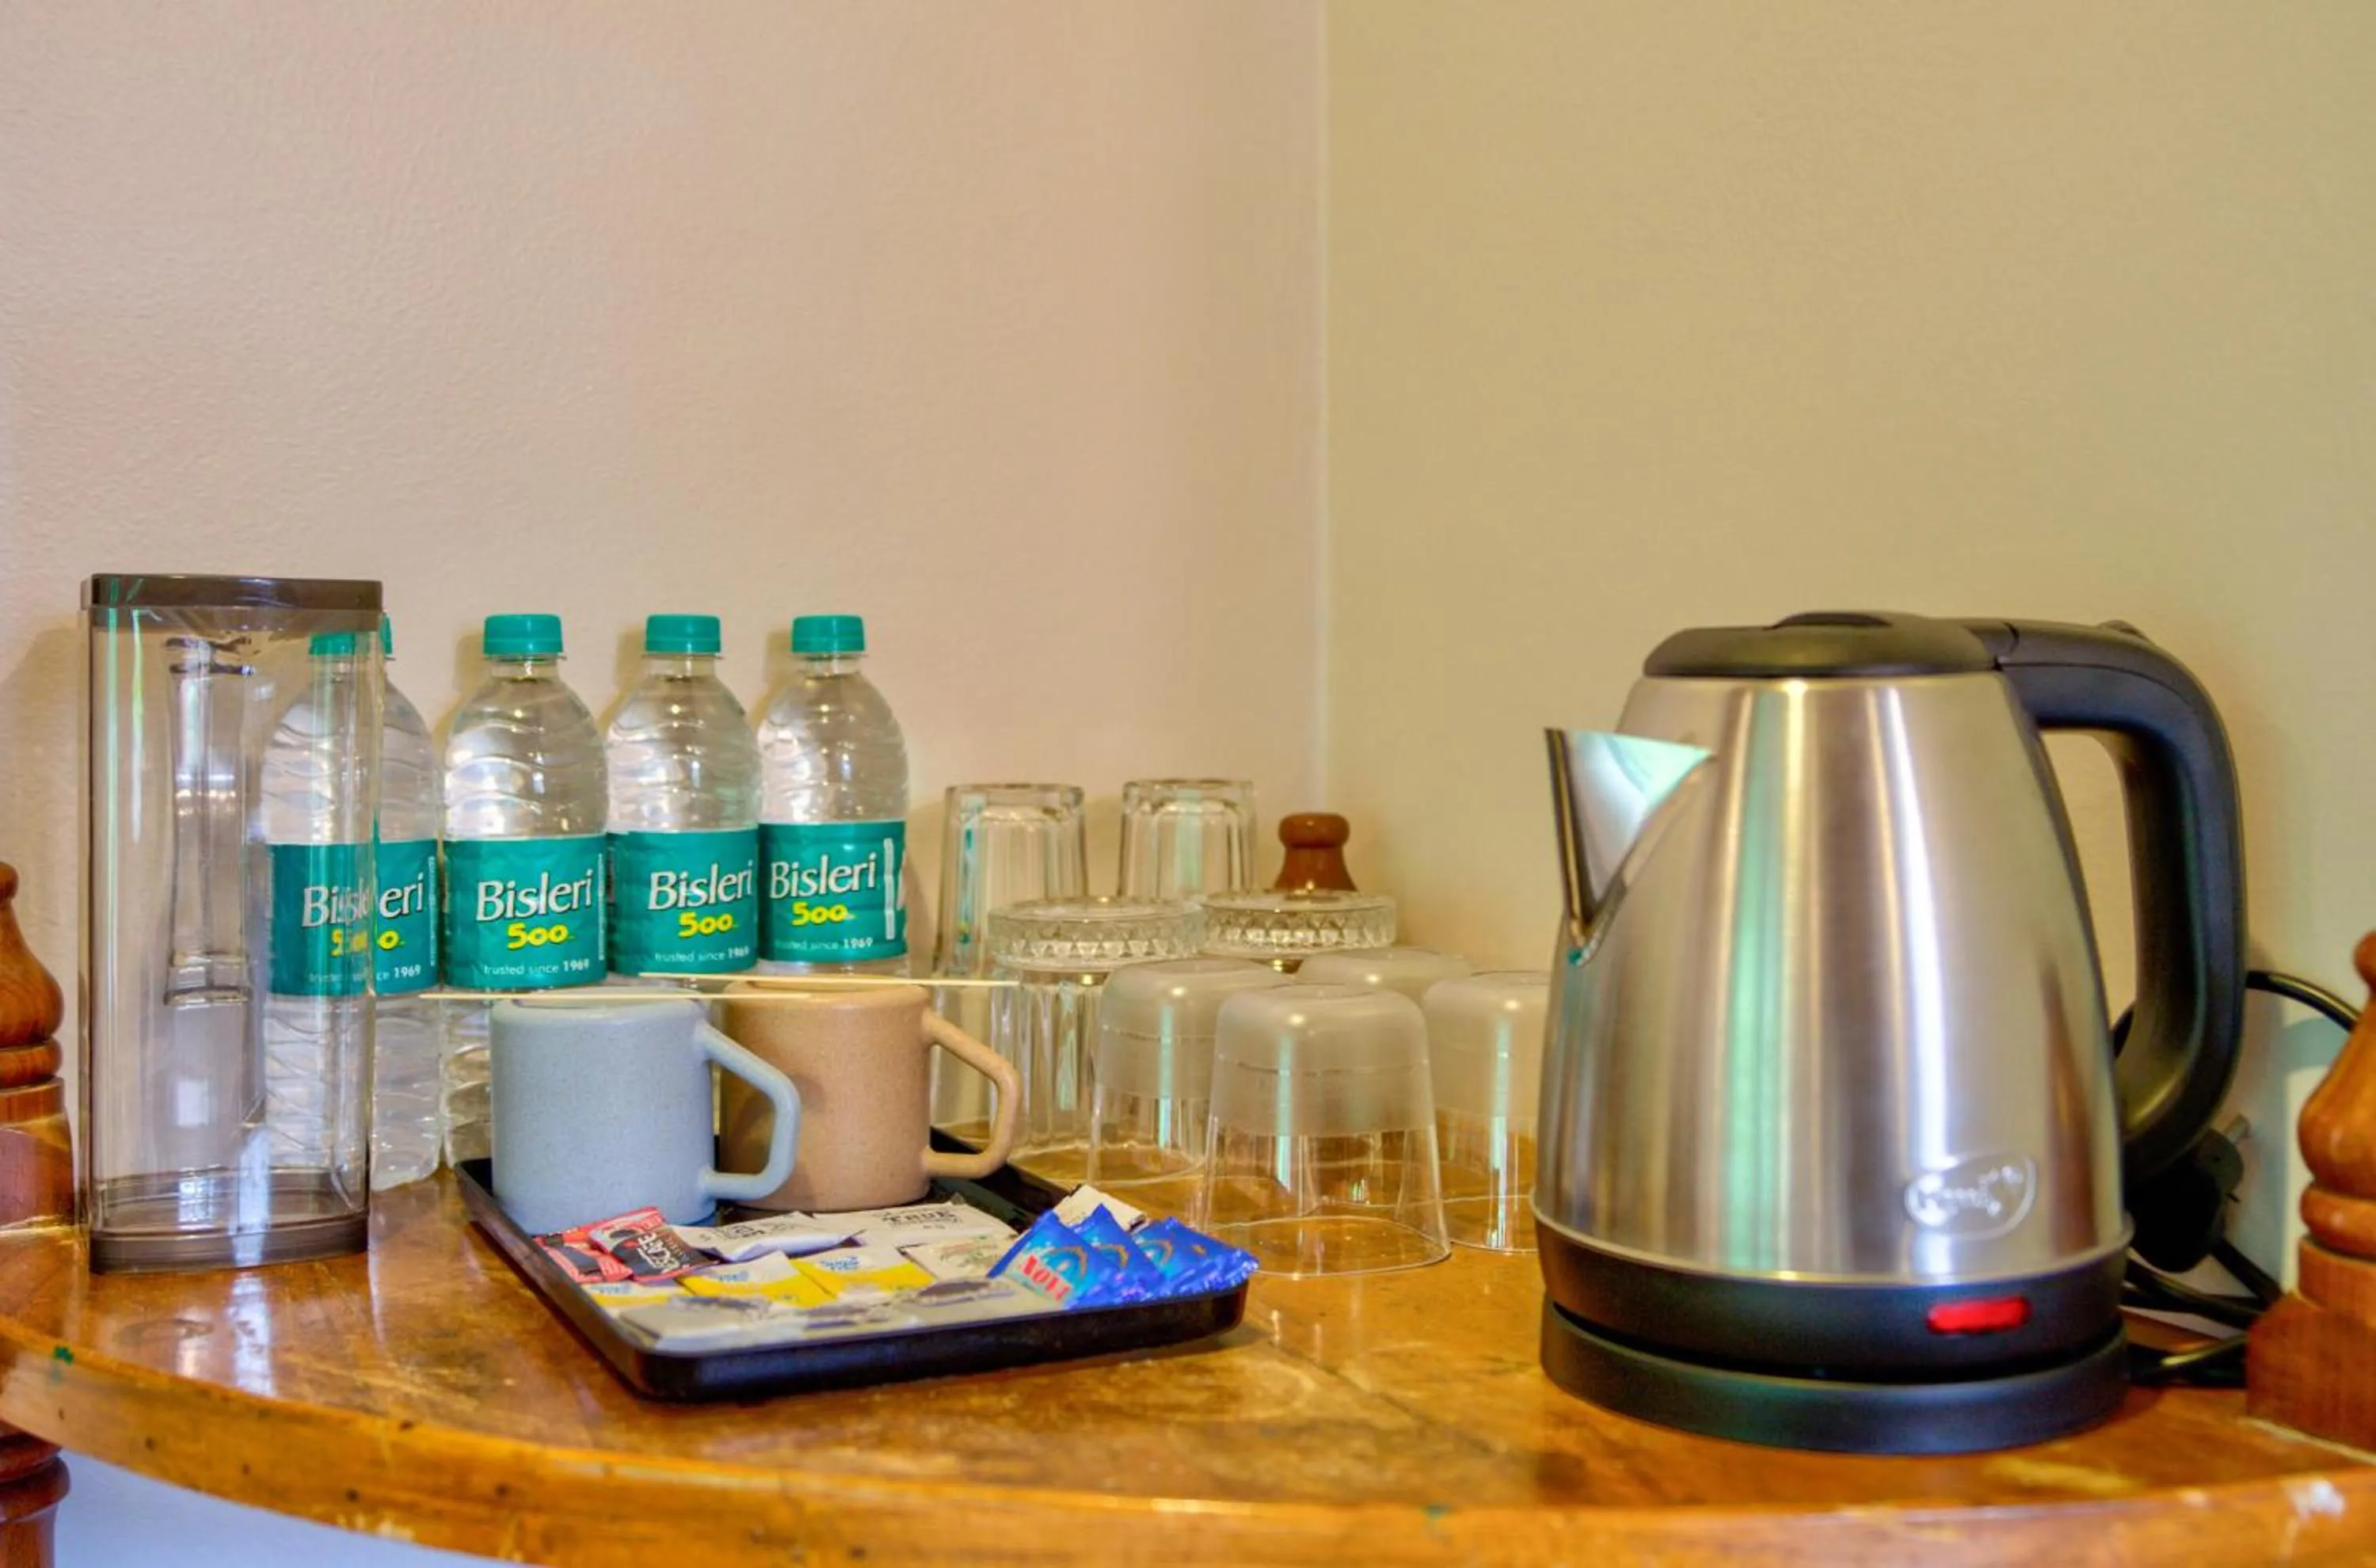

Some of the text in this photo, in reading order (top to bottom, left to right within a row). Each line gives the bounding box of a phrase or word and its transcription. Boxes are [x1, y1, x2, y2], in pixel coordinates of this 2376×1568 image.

[647, 860, 753, 911] Bisleri
[770, 852, 877, 900] Bisleri
[476, 868, 594, 923] Bisleri
[678, 911, 733, 938] 500
[792, 900, 847, 926] 500
[507, 923, 569, 950] 500
[394, 965, 421, 979] 1969
[484, 963, 524, 975] trusted
